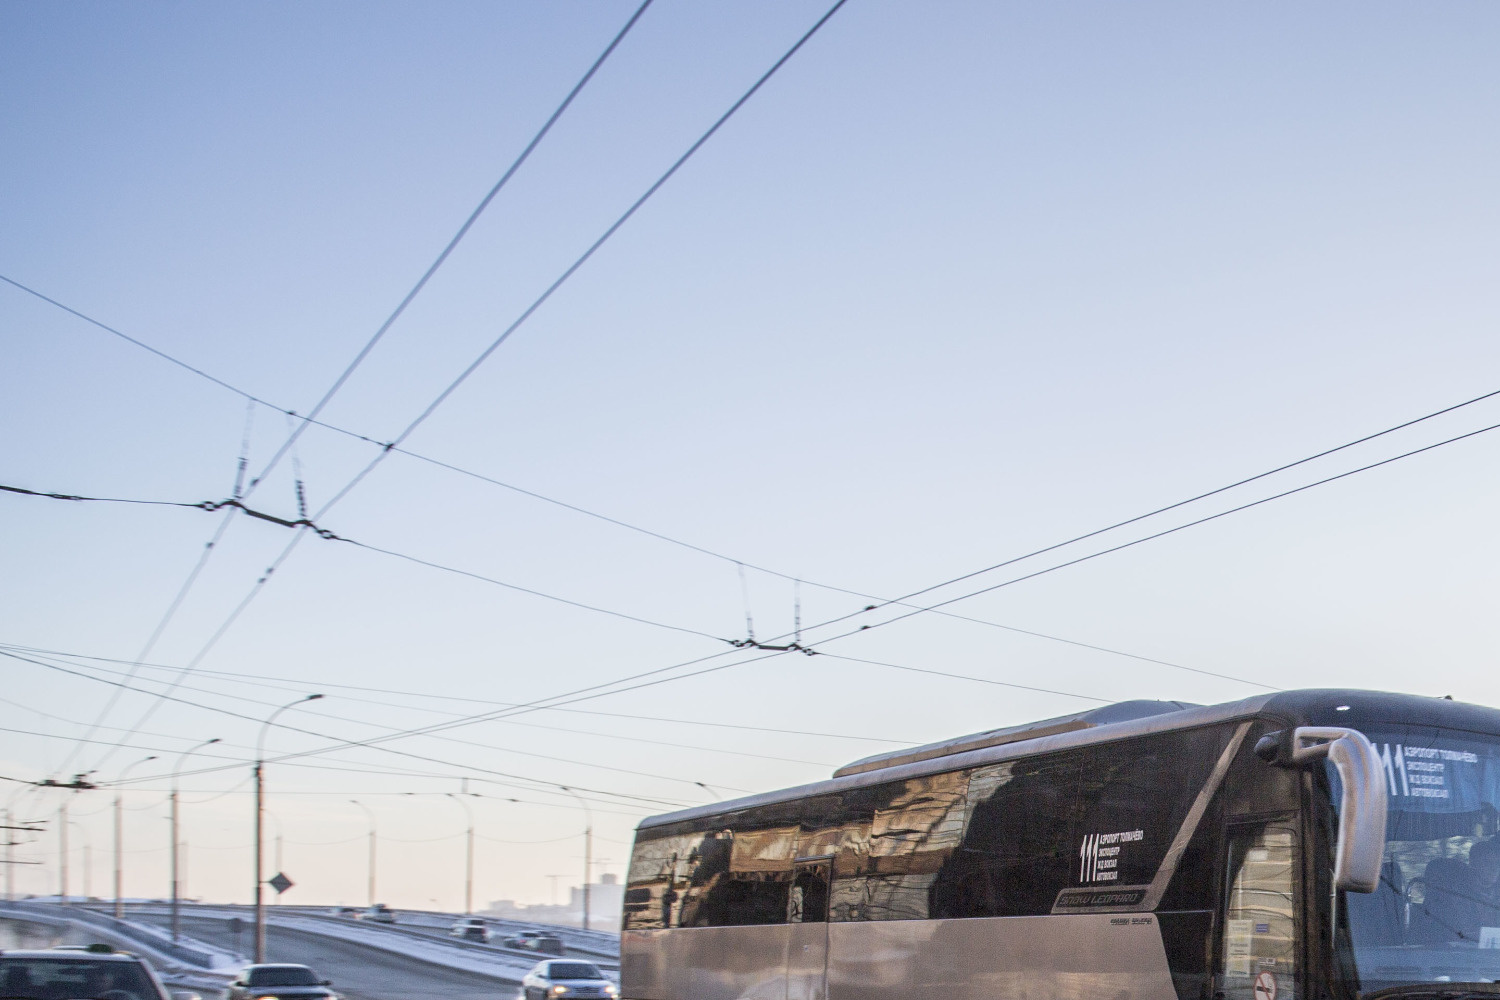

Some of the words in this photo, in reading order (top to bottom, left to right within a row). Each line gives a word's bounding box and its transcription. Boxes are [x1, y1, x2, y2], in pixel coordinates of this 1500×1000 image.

[1404, 746, 1439, 759] АЭРОПОРТ
[1100, 832, 1120, 845] АЭРОПОРТ
[1080, 833, 1100, 882] 111
[1060, 896, 1090, 905] SNOW
[1090, 893, 1138, 904] LEOPARD
